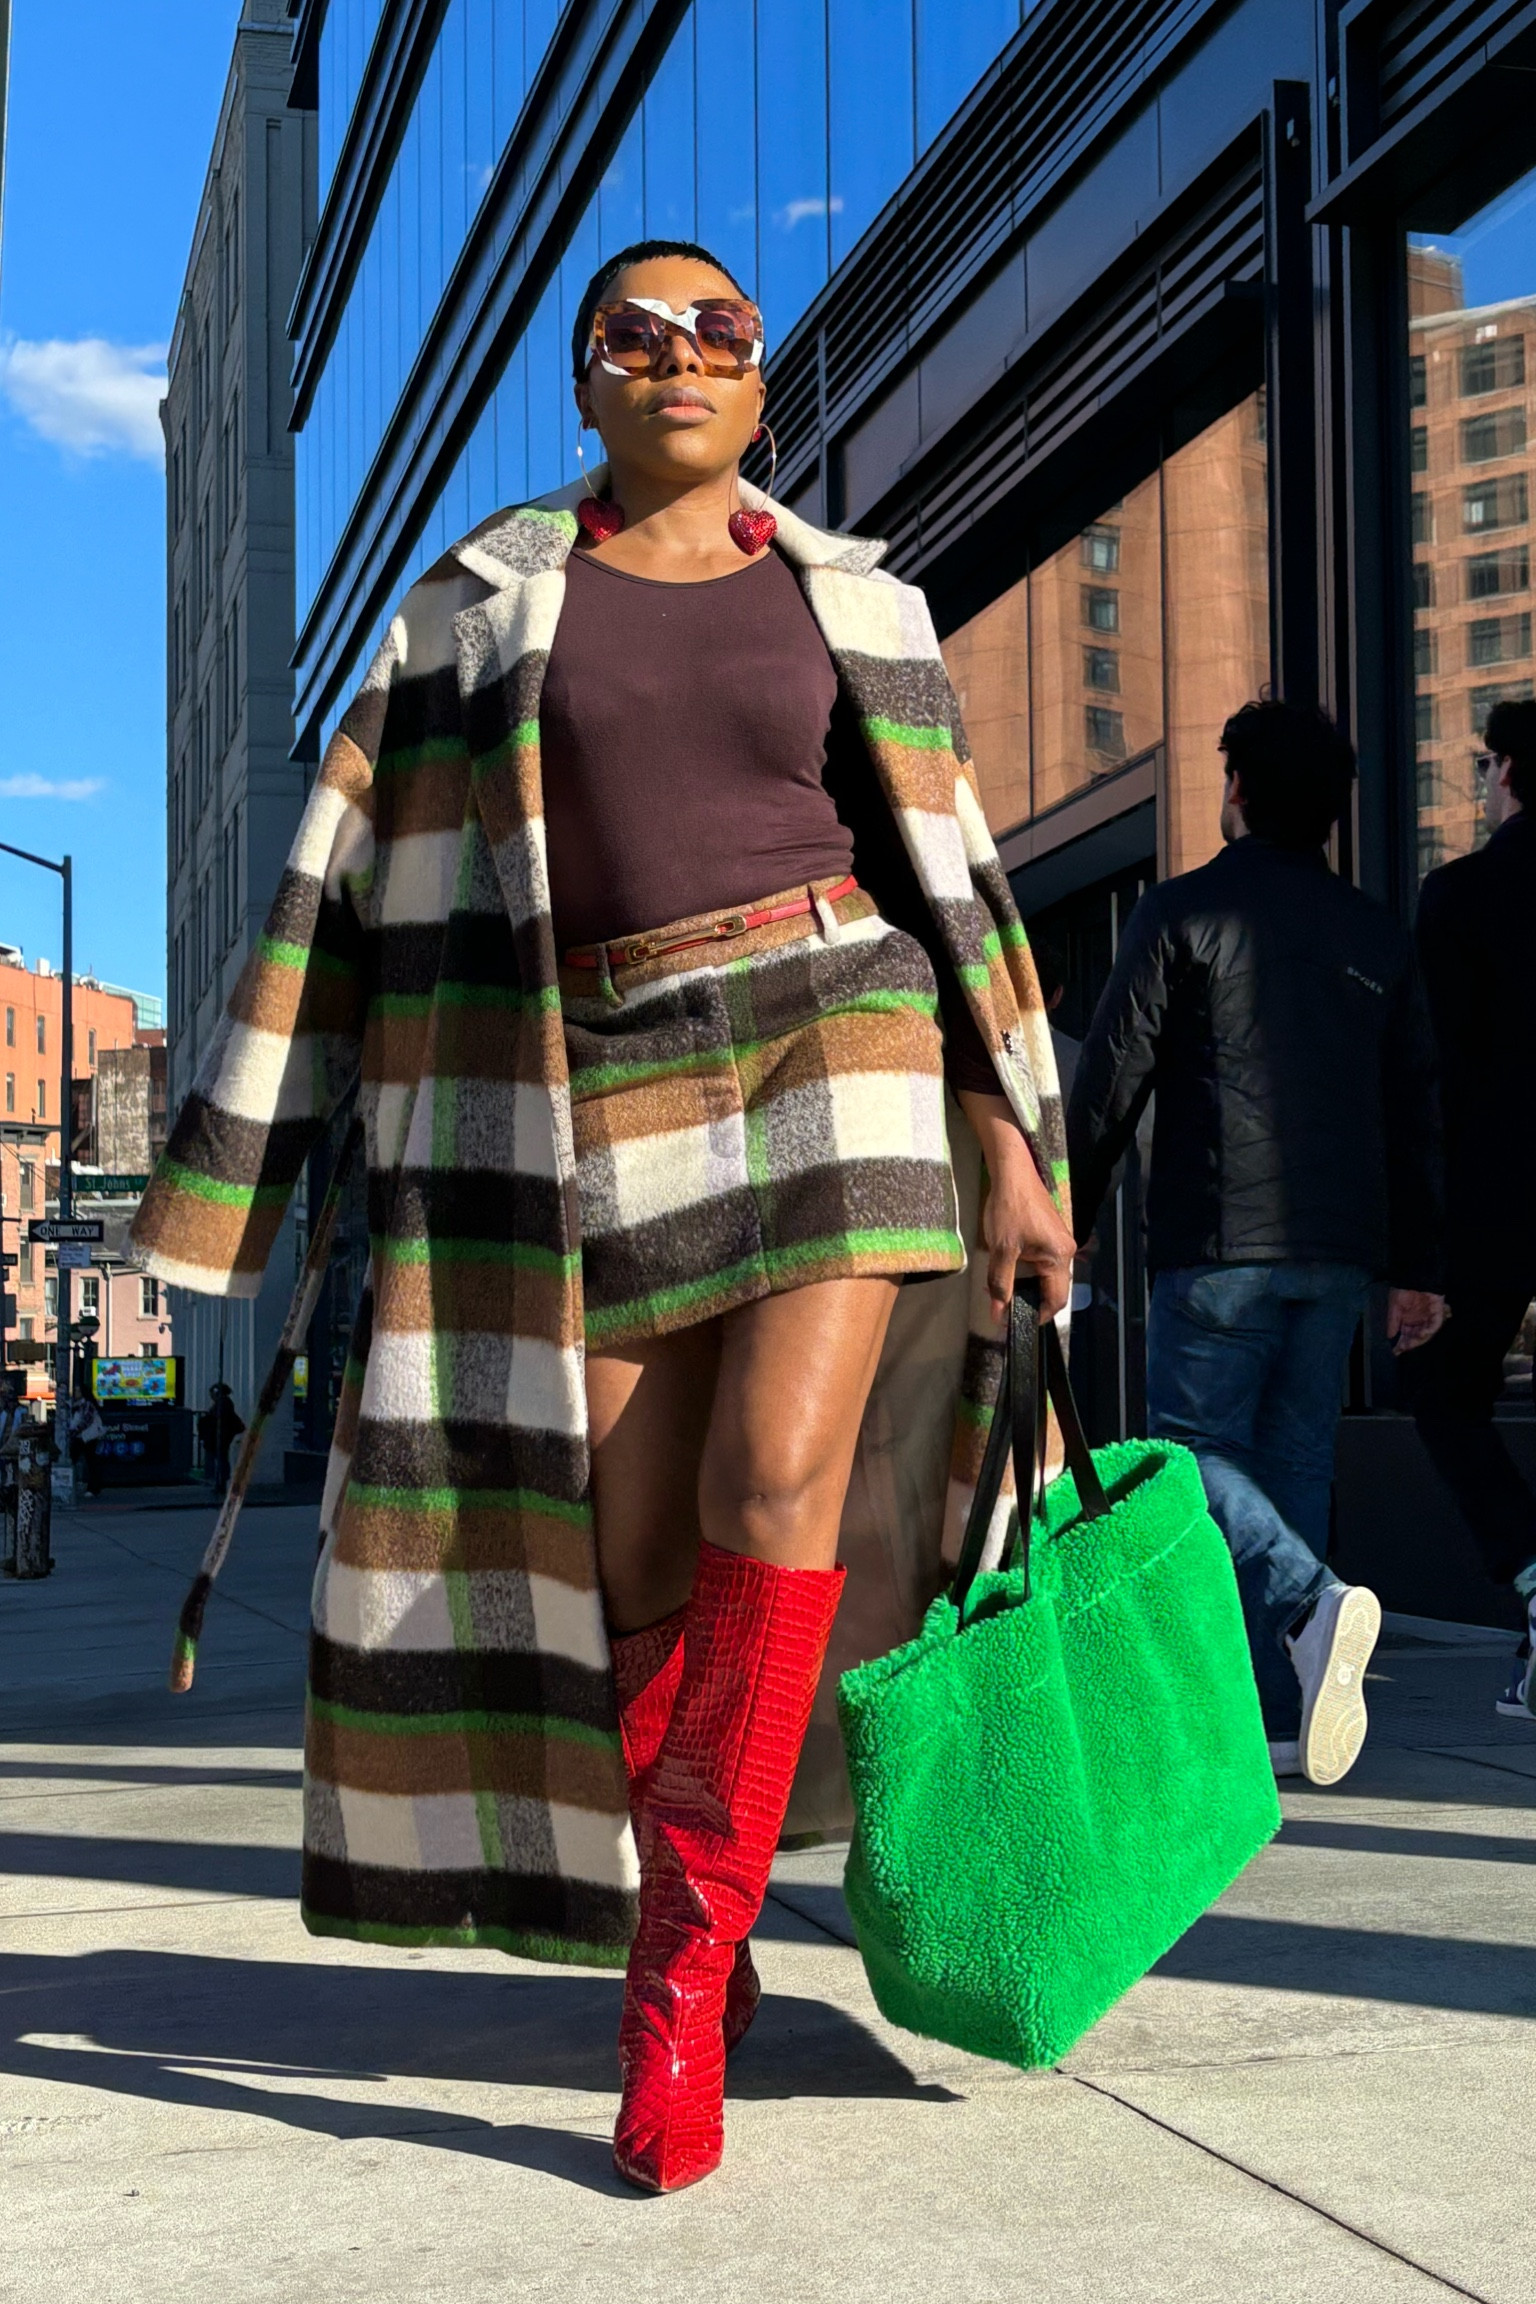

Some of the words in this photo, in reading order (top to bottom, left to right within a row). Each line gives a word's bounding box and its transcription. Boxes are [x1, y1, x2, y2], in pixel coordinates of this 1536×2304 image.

[99, 1175, 131, 1190] Johns
[40, 1225, 60, 1237] ONE
[71, 1225, 94, 1237] WAY
